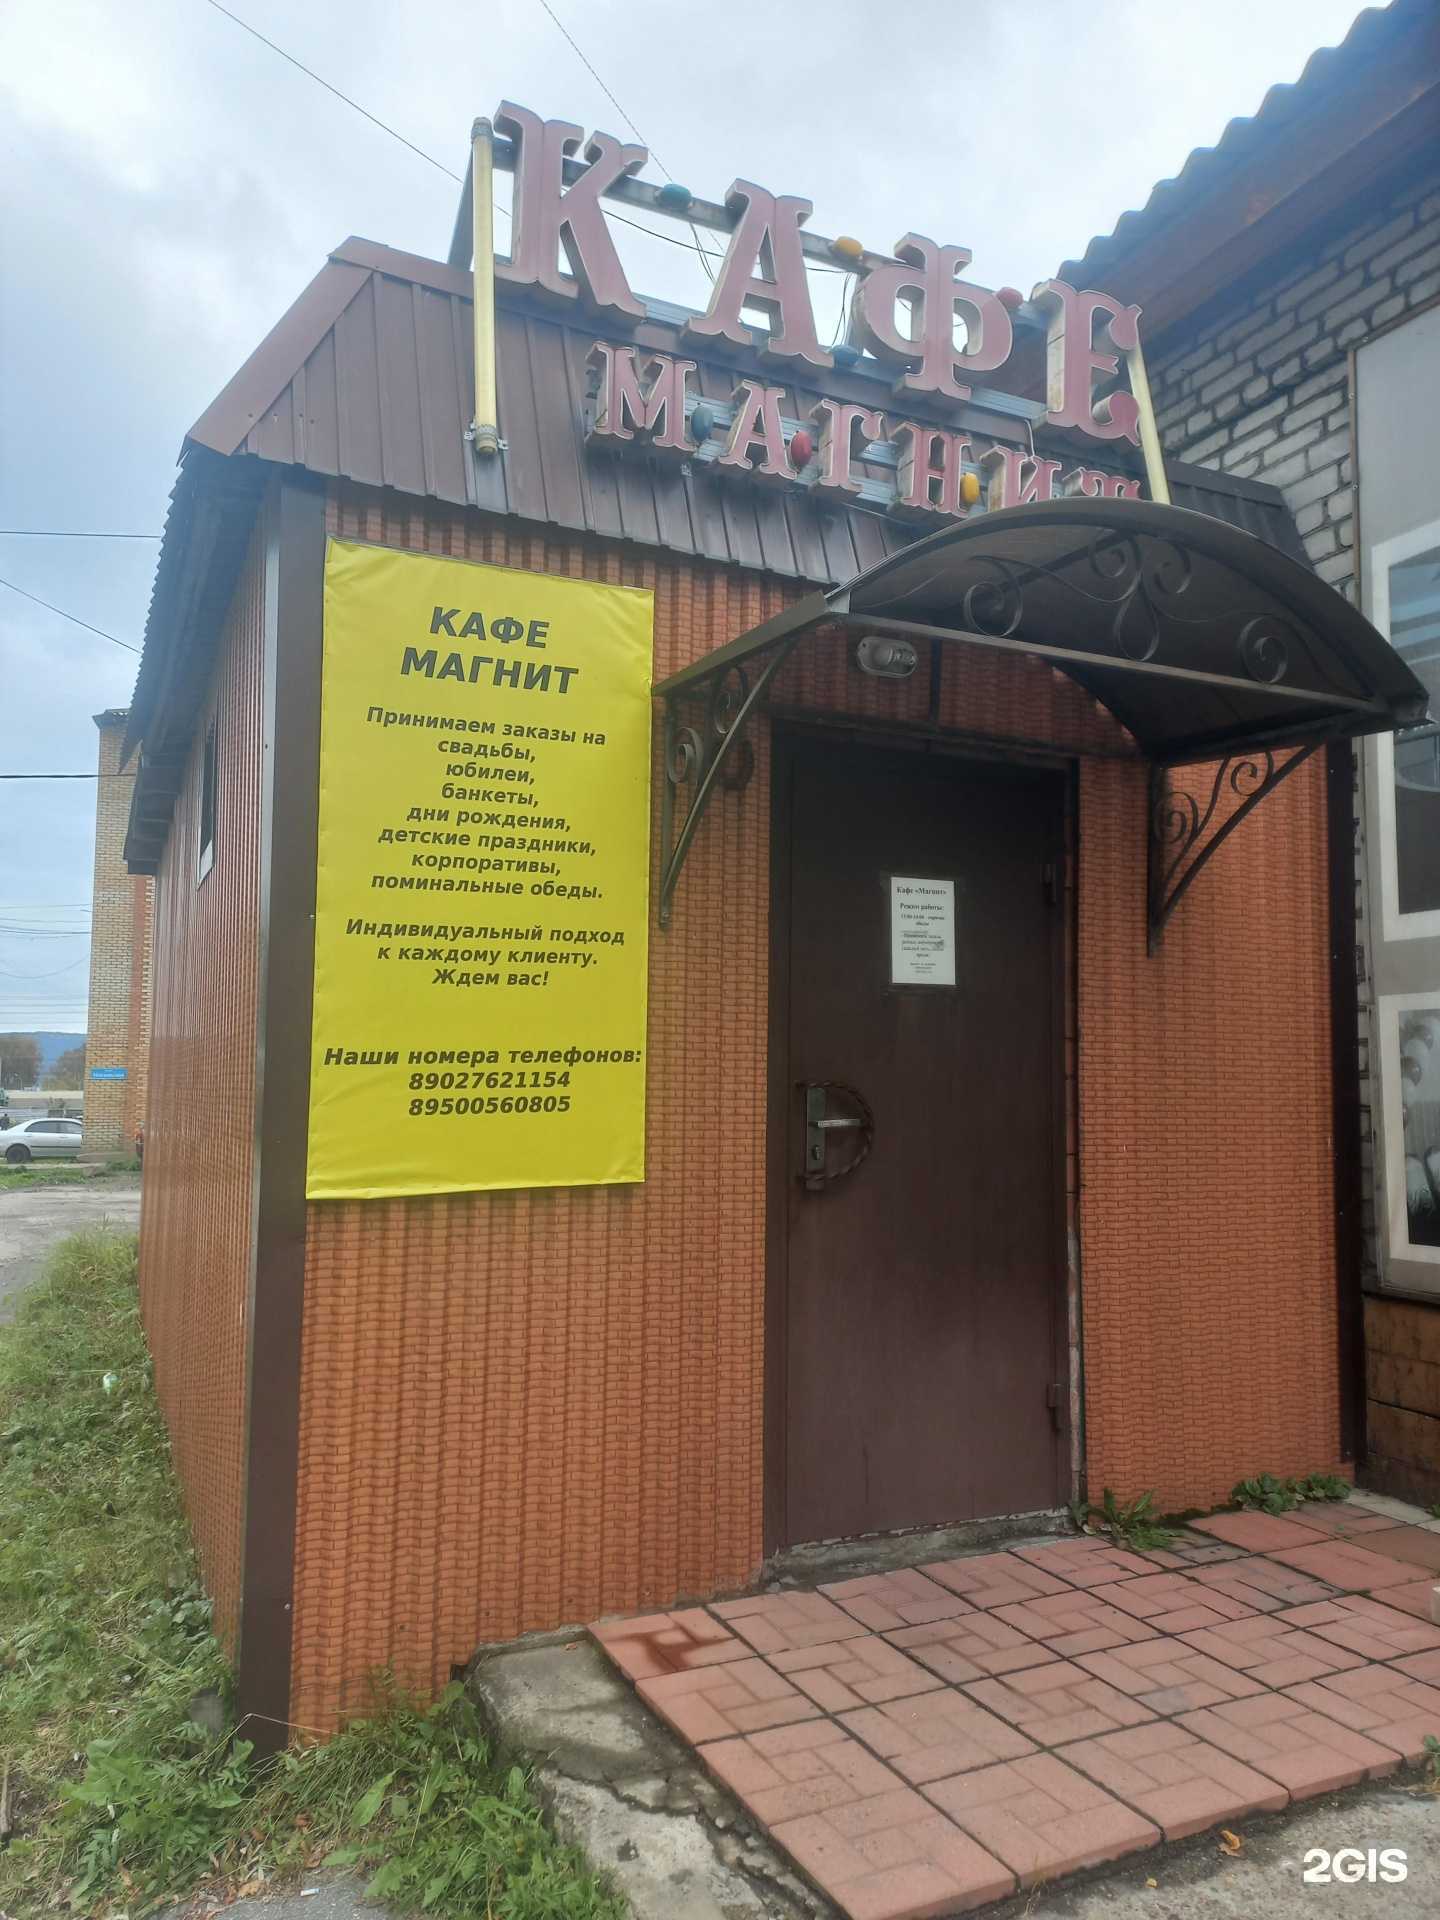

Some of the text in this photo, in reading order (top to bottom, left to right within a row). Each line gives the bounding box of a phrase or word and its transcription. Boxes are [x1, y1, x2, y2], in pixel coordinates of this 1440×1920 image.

[493, 100, 1143, 446] КАФЕ
[430, 607, 550, 648] КАФЕ
[401, 647, 579, 694] МАГНИТ
[367, 706, 605, 745] Принимаем заказы на
[438, 741, 535, 763] свадьбы,
[446, 762, 534, 785] юбилеи,
[442, 783, 538, 808] банкеты,
[407, 808, 570, 832] дни рождения,
[378, 829, 595, 856] детские праздники,
[412, 854, 560, 876] корпоративы,
[371, 876, 602, 900] поминальные обеды.
[346, 919, 624, 945] Индивидуальный подход
[378, 947, 597, 968] к каждому клиенту.
[432, 969, 548, 987] Ждем вас!
[324, 1046, 641, 1068] Наши номера телефонов:
[409, 1071, 570, 1090] 89027621154
[409, 1096, 570, 1116] 89500560805
